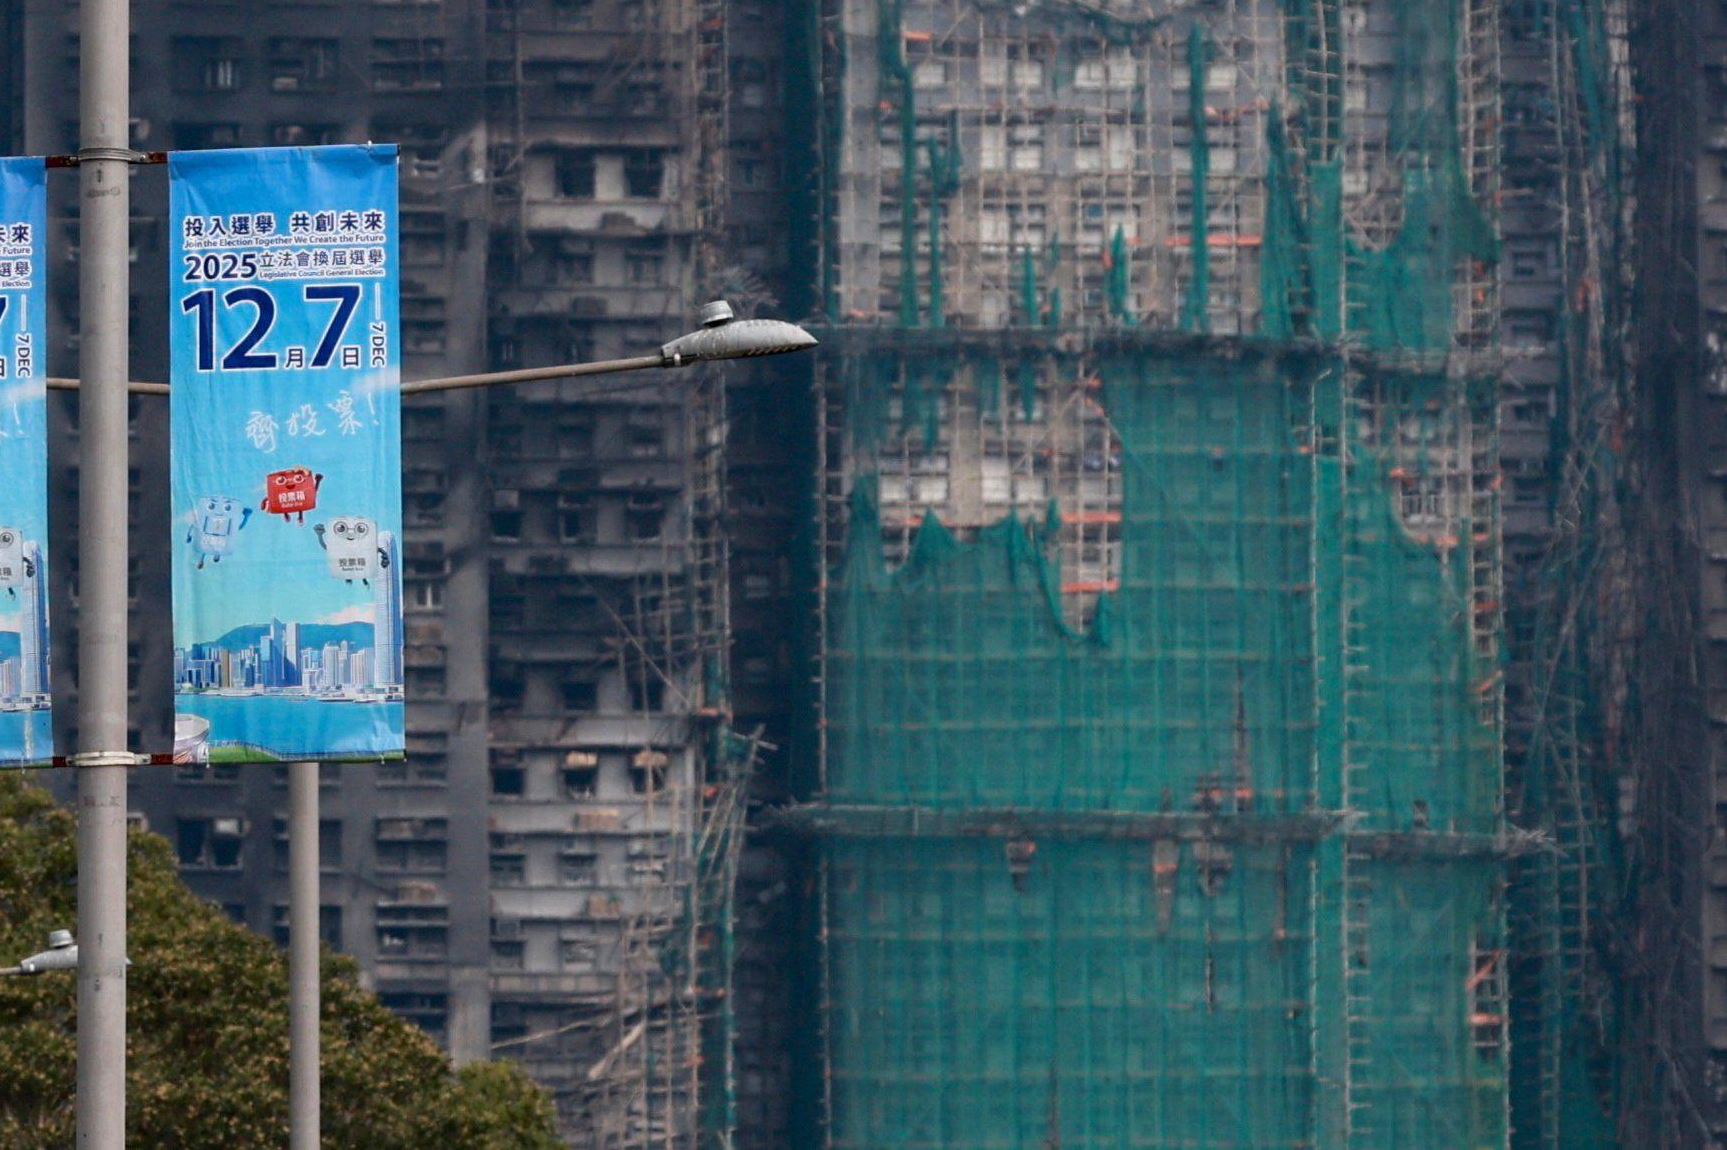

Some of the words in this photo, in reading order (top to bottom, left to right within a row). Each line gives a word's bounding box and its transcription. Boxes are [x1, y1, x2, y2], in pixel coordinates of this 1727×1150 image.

[185, 214, 274, 237] 投入選舉
[291, 211, 383, 232] 共創未來
[185, 240, 203, 249] Join
[204, 239, 218, 247] the
[219, 238, 253, 247] Election
[254, 236, 292, 246] Together
[294, 236, 308, 244] We
[309, 235, 338, 243] Create
[339, 234, 354, 242] the
[355, 233, 384, 242] Future
[2, 246, 31, 255] Future
[185, 253, 257, 280] 2025
[298, 269, 325, 277] Council
[326, 268, 353, 276] General
[354, 267, 384, 275] Election
[1, 280, 31, 288] Election
[372, 323, 384, 332] 7
[17, 334, 30, 343] 7
[372, 336, 384, 366] DEC
[17, 347, 30, 377] DEC
